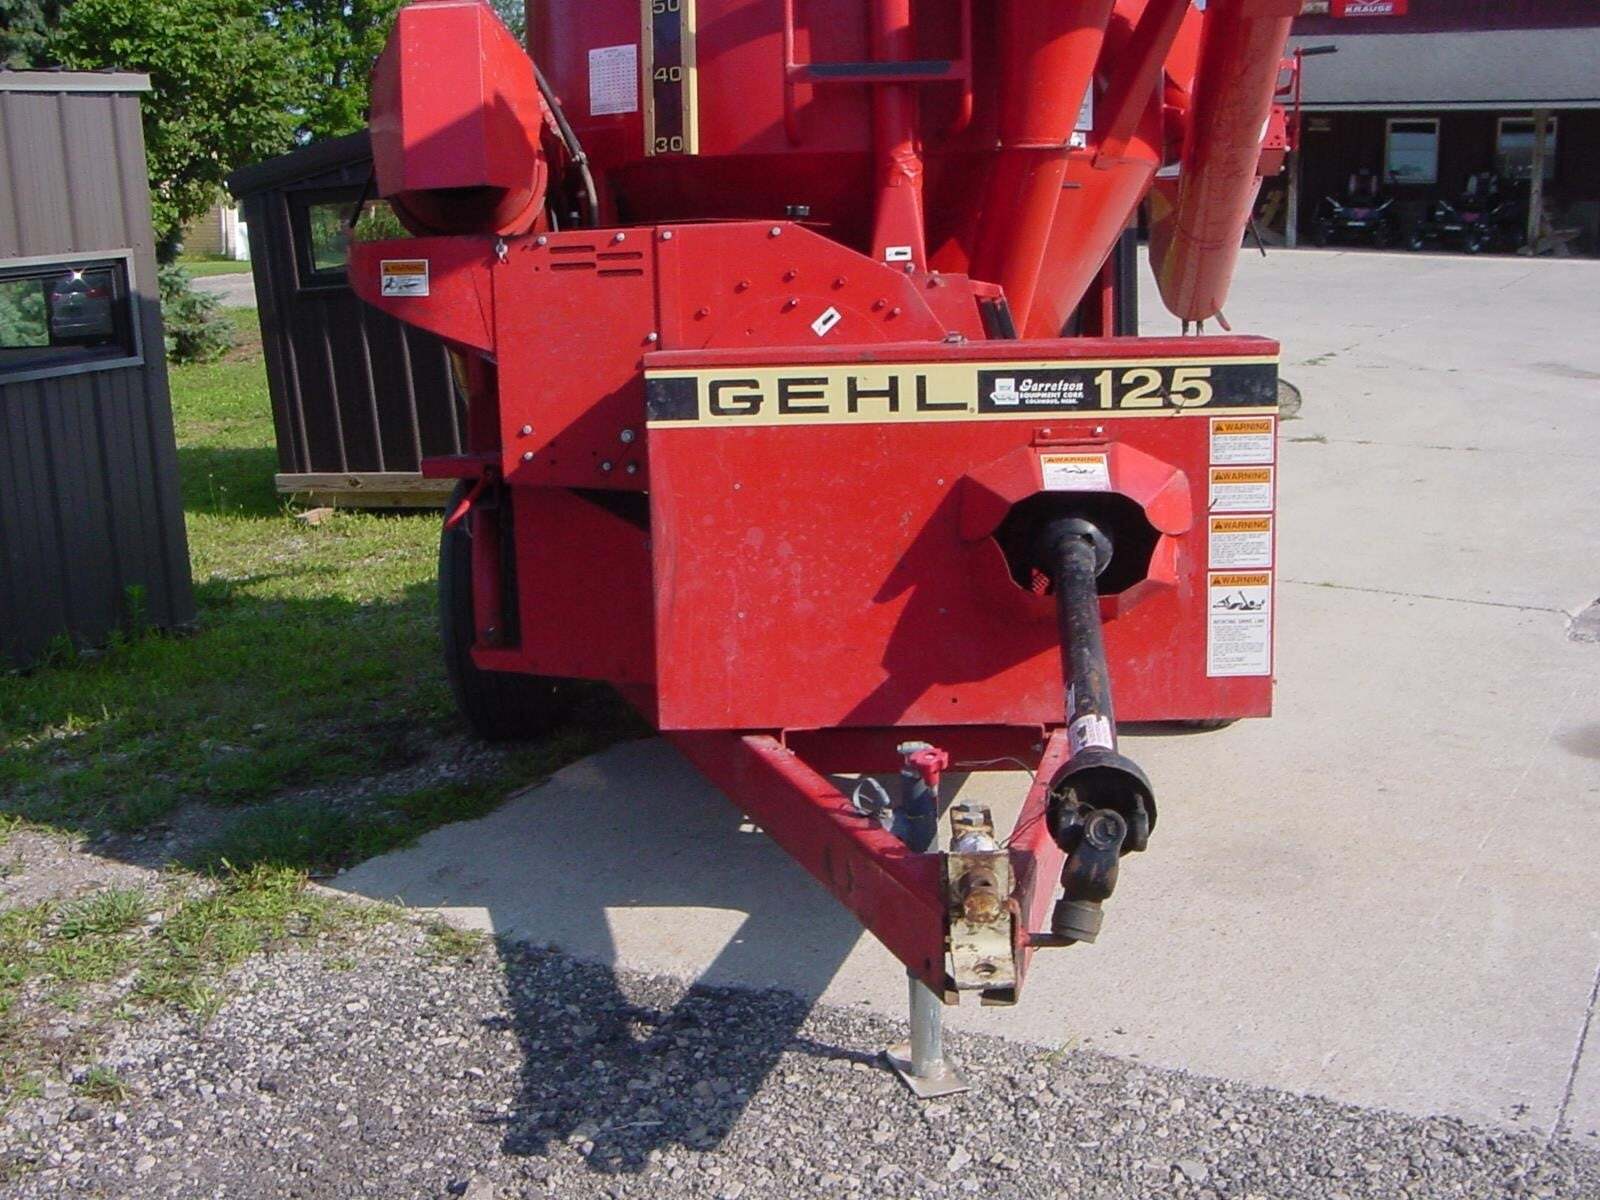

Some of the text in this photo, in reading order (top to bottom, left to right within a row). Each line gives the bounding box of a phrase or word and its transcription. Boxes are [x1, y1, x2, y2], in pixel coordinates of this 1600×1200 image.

[652, 0, 681, 14] 50
[1344, 4, 1393, 13] KRAUSE
[654, 66, 682, 82] 40
[655, 136, 683, 152] 30
[1094, 367, 1213, 408] 125
[708, 375, 969, 416] GEHL
[1224, 422, 1269, 431] WARNING
[1223, 472, 1268, 480] WARNING
[1223, 519, 1268, 529] WARNING
[1222, 575, 1268, 584] WARNING
